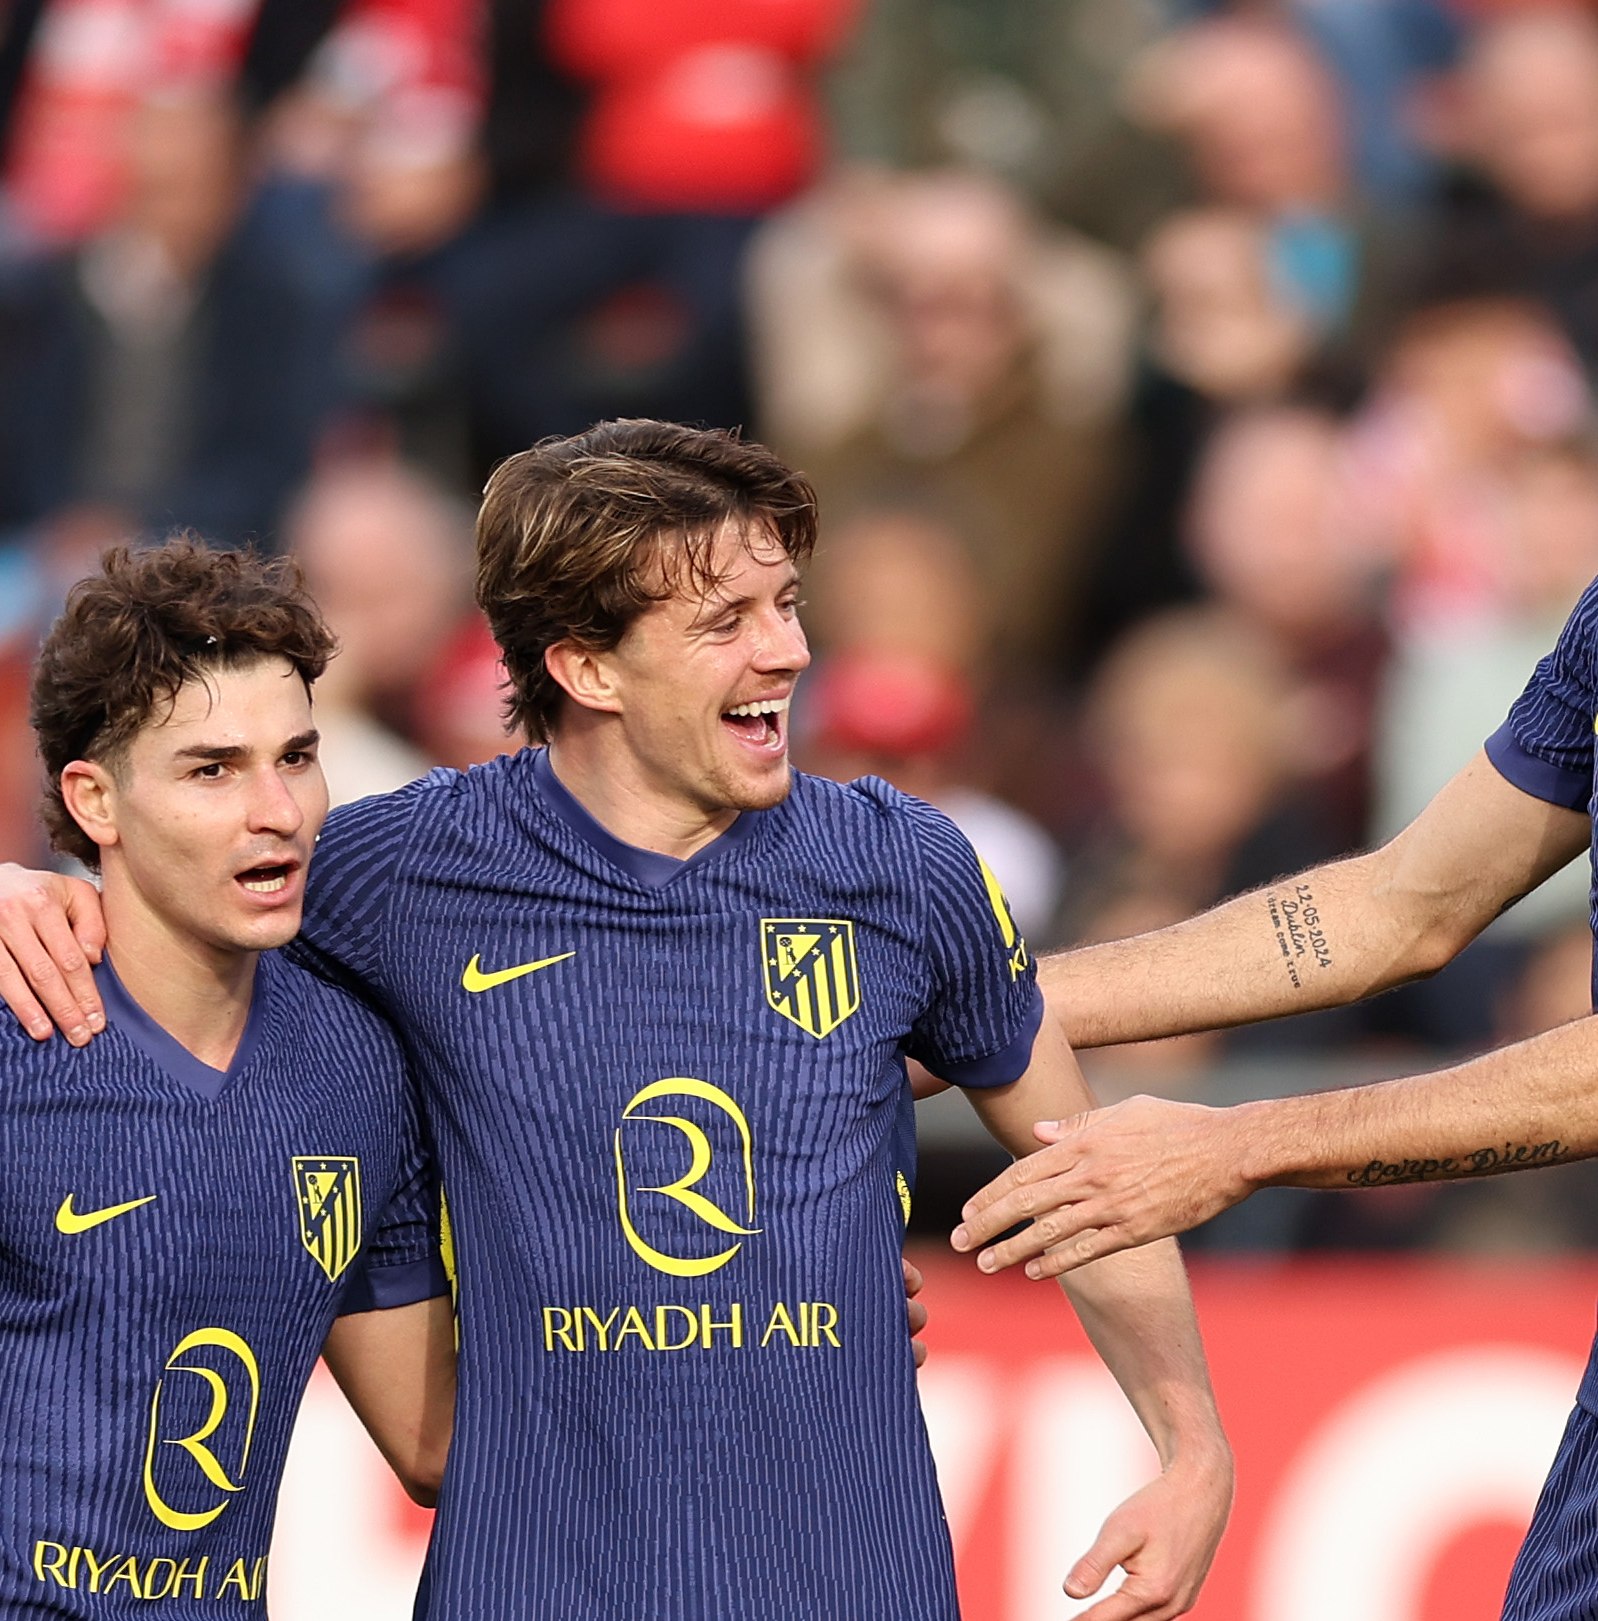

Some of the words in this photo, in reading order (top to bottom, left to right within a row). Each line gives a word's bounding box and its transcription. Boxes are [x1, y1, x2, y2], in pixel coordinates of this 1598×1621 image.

[1281, 899, 1306, 958] Dublin
[1287, 960, 1302, 989] true
[1462, 1139, 1570, 1174] Diem
[542, 1305, 742, 1352] RIYADH
[761, 1302, 841, 1348] AIR
[34, 1540, 209, 1600] RIYADH
